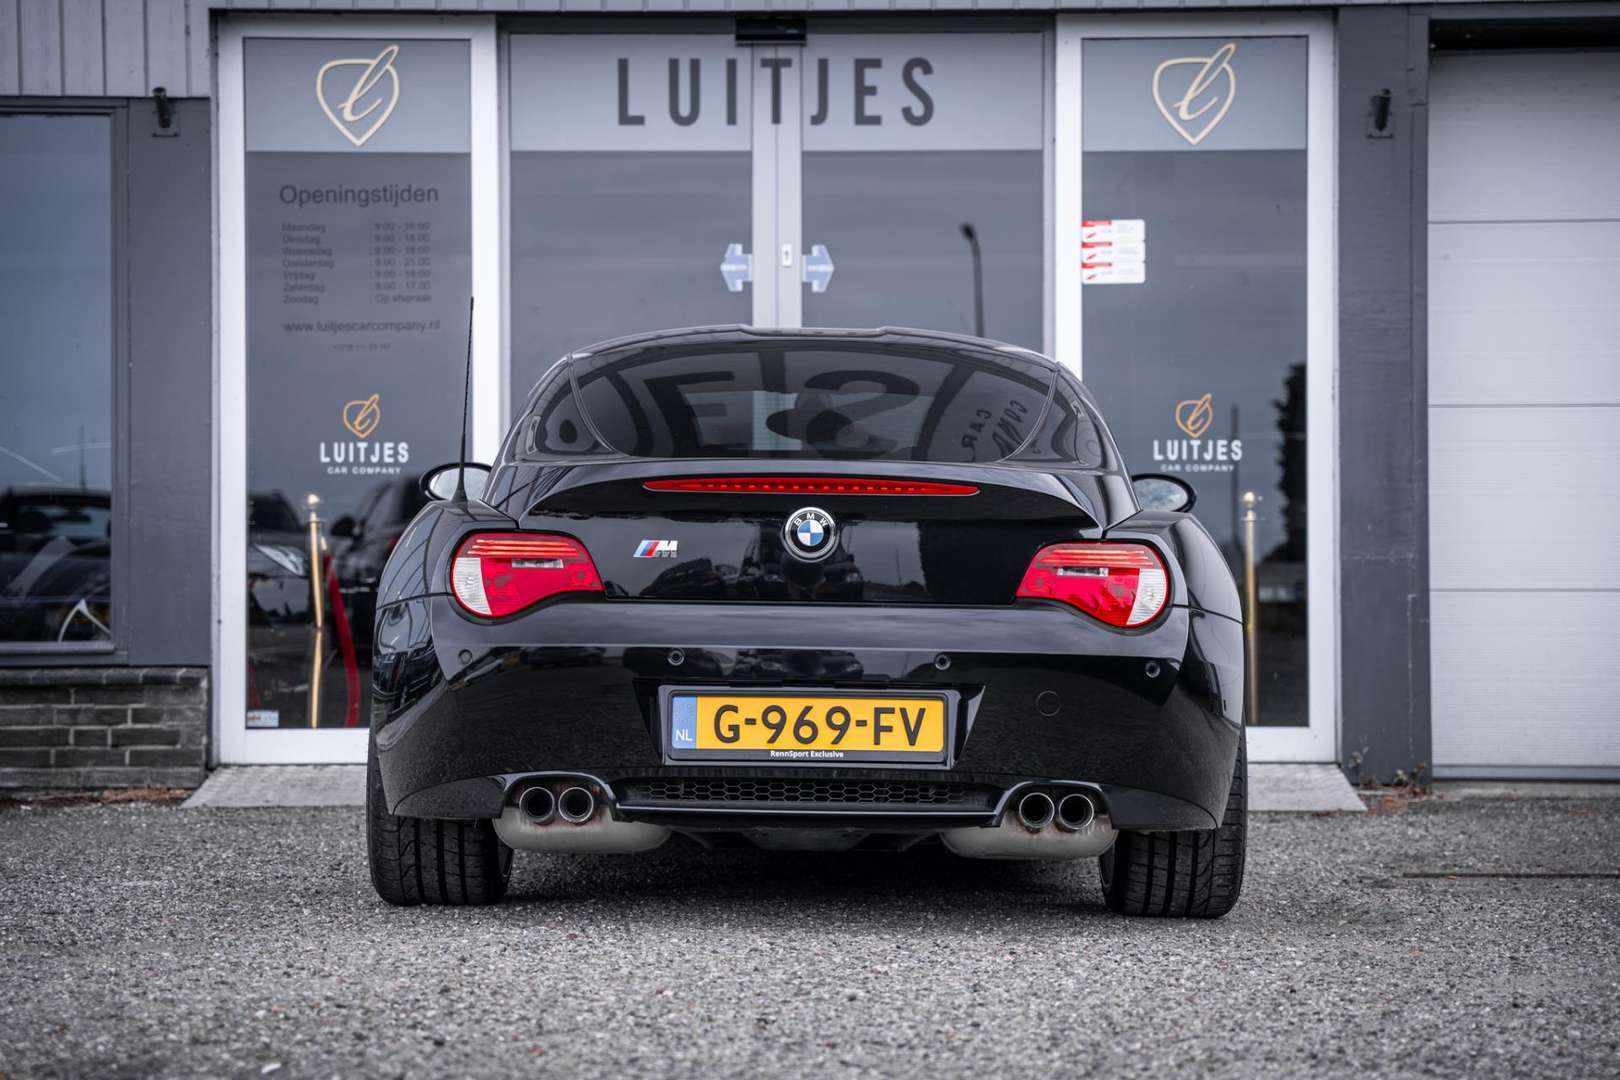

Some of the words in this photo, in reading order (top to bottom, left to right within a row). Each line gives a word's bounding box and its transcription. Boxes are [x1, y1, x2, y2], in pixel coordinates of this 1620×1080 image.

[617, 57, 935, 127] LUITJES
[279, 184, 439, 208] Openingstijden
[320, 442, 409, 463] LUITJES
[1153, 440, 1242, 461] LUITJES
[327, 466, 348, 475] CAR
[352, 466, 401, 475] COMPANY
[1160, 463, 1181, 472] CAR
[1185, 463, 1234, 472] COMPANY
[794, 513, 828, 527] BMW
[675, 729, 692, 742] NL
[714, 704, 926, 746] G-969-FV
[770, 750, 808, 759] RennSport
[810, 750, 844, 759] Exclusive
